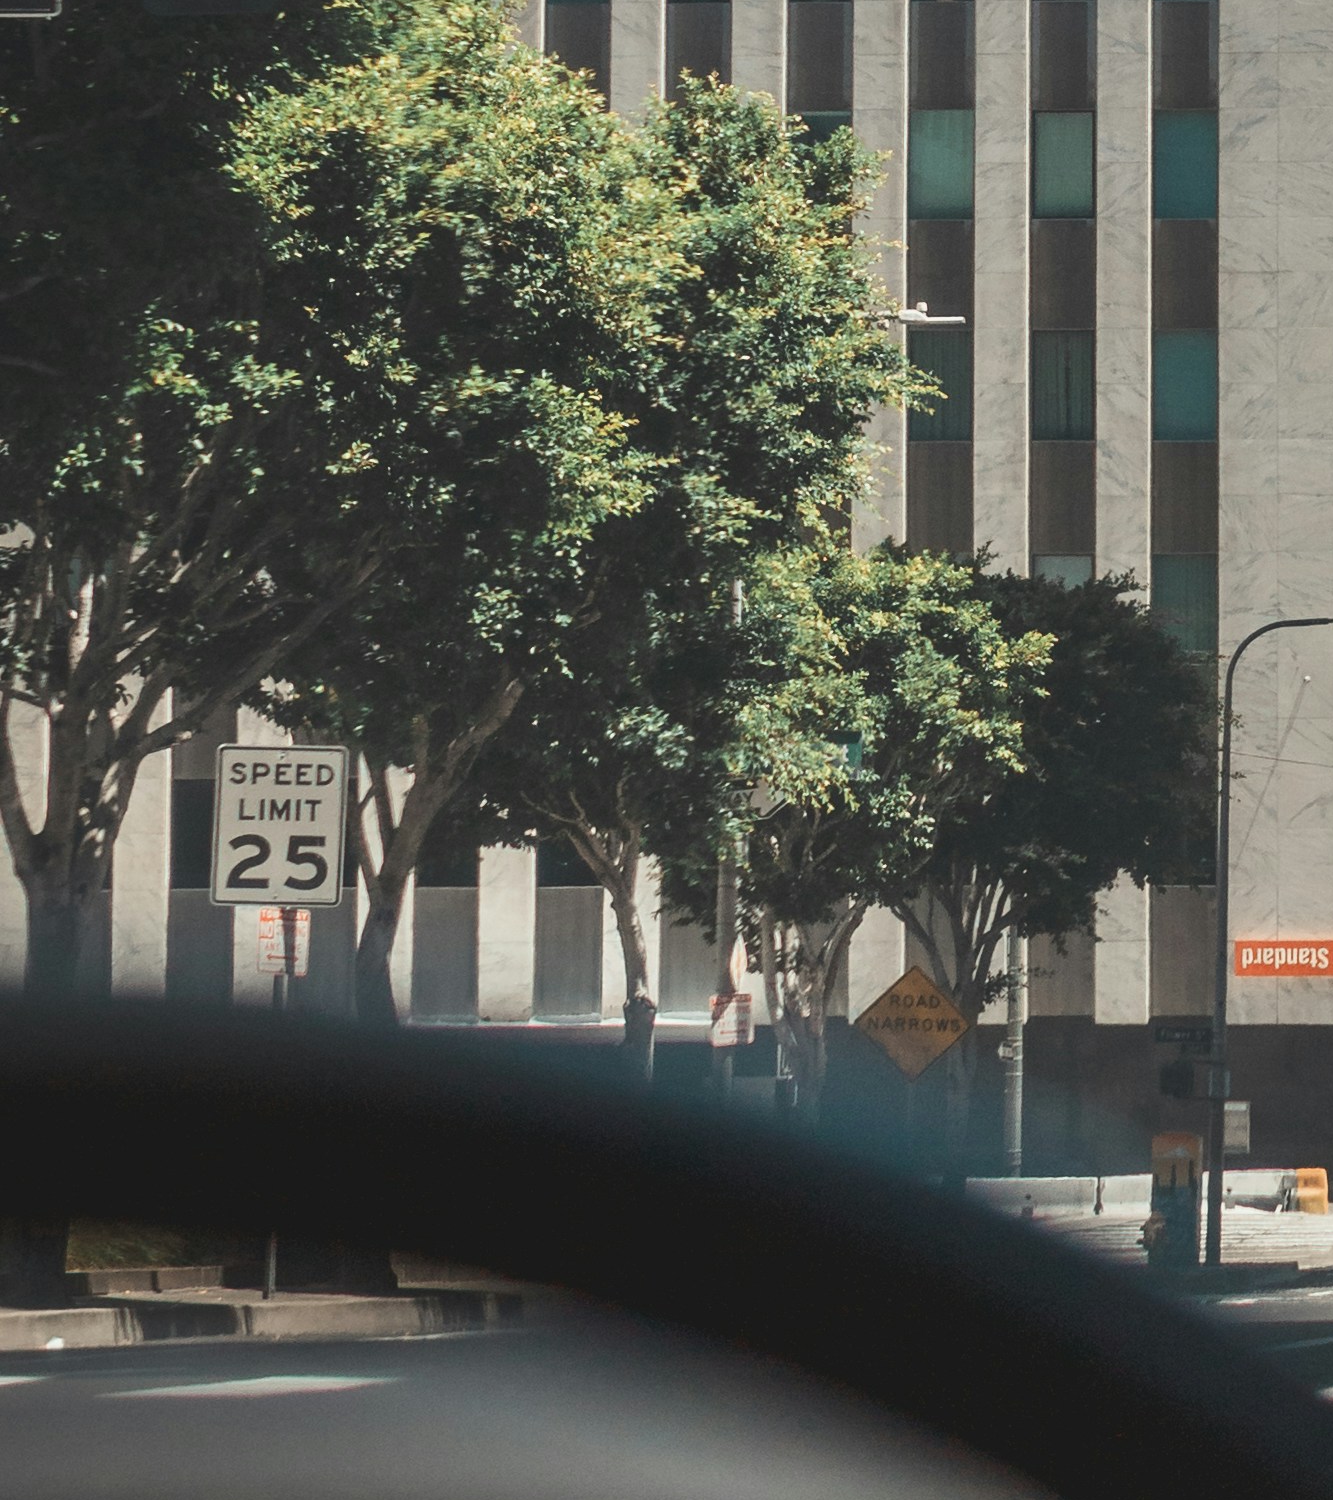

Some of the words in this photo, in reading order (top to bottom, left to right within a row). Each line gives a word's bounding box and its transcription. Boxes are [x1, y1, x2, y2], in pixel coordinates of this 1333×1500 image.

[230, 762, 335, 786] SPEED
[238, 799, 322, 822] LIMIT
[225, 834, 329, 891] 25
[1241, 947, 1329, 969] Standard
[890, 995, 940, 1009] ROAD
[868, 1017, 960, 1033] NARROWS
